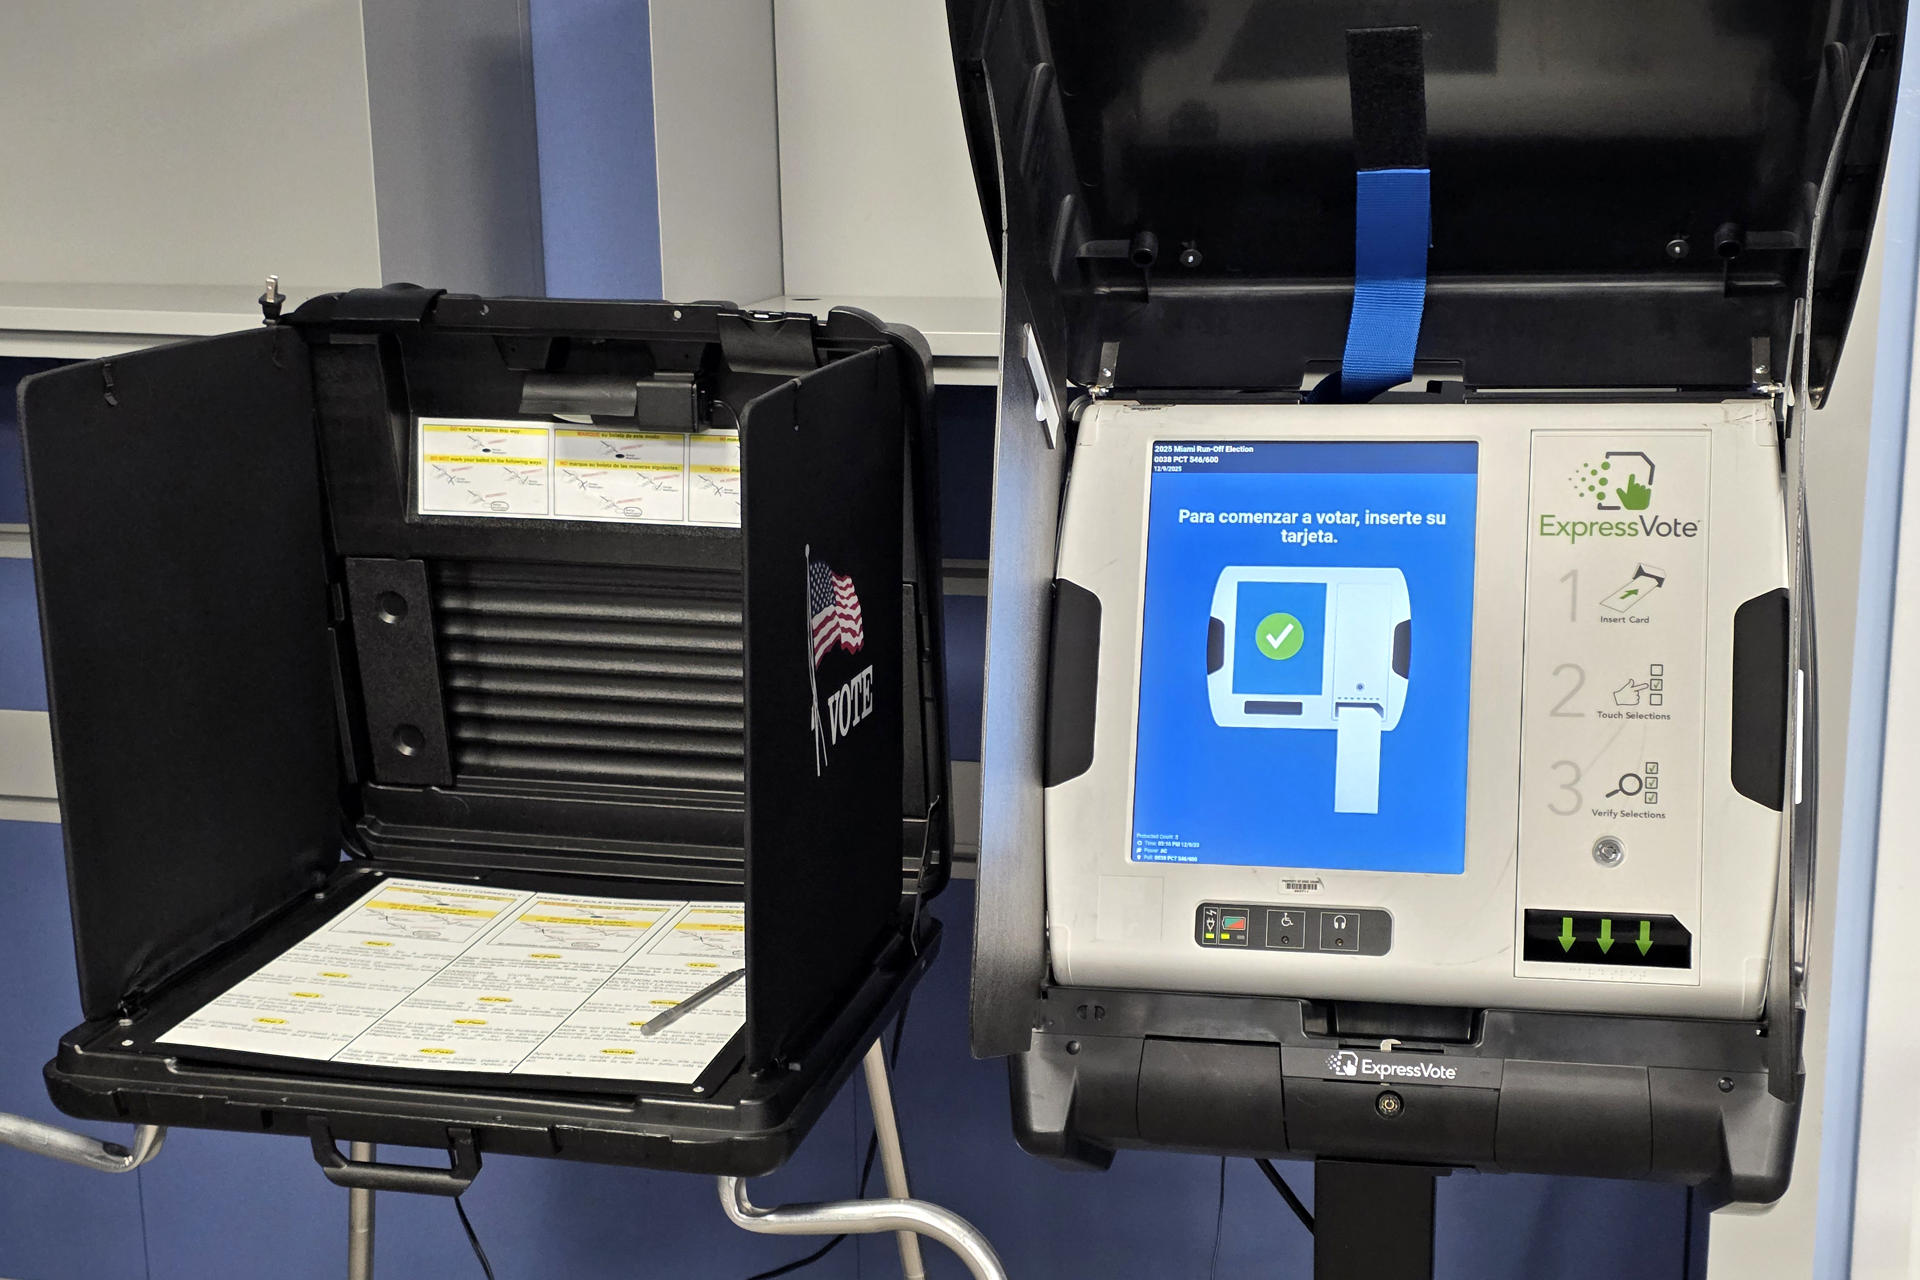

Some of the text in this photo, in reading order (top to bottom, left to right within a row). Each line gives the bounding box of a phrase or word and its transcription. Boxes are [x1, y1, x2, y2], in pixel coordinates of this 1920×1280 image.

[1154, 445, 1254, 453] 2025 Miami Run-Off Election
[1178, 509, 1446, 528] Para comenzar a votar, inserte su
[1281, 529, 1338, 547] tarjeta.
[1539, 514, 1699, 545] ExpressVote
[1560, 568, 1578, 622] 1
[1600, 616, 1650, 624] Insert Card
[1550, 663, 1586, 718] 2
[827, 664, 873, 746] VOTE
[1597, 710, 1671, 721] Touch Selections
[1547, 760, 1583, 816] 3
[1592, 809, 1666, 819] Verify Selections
[1361, 1058, 1457, 1080] ExpressVote
